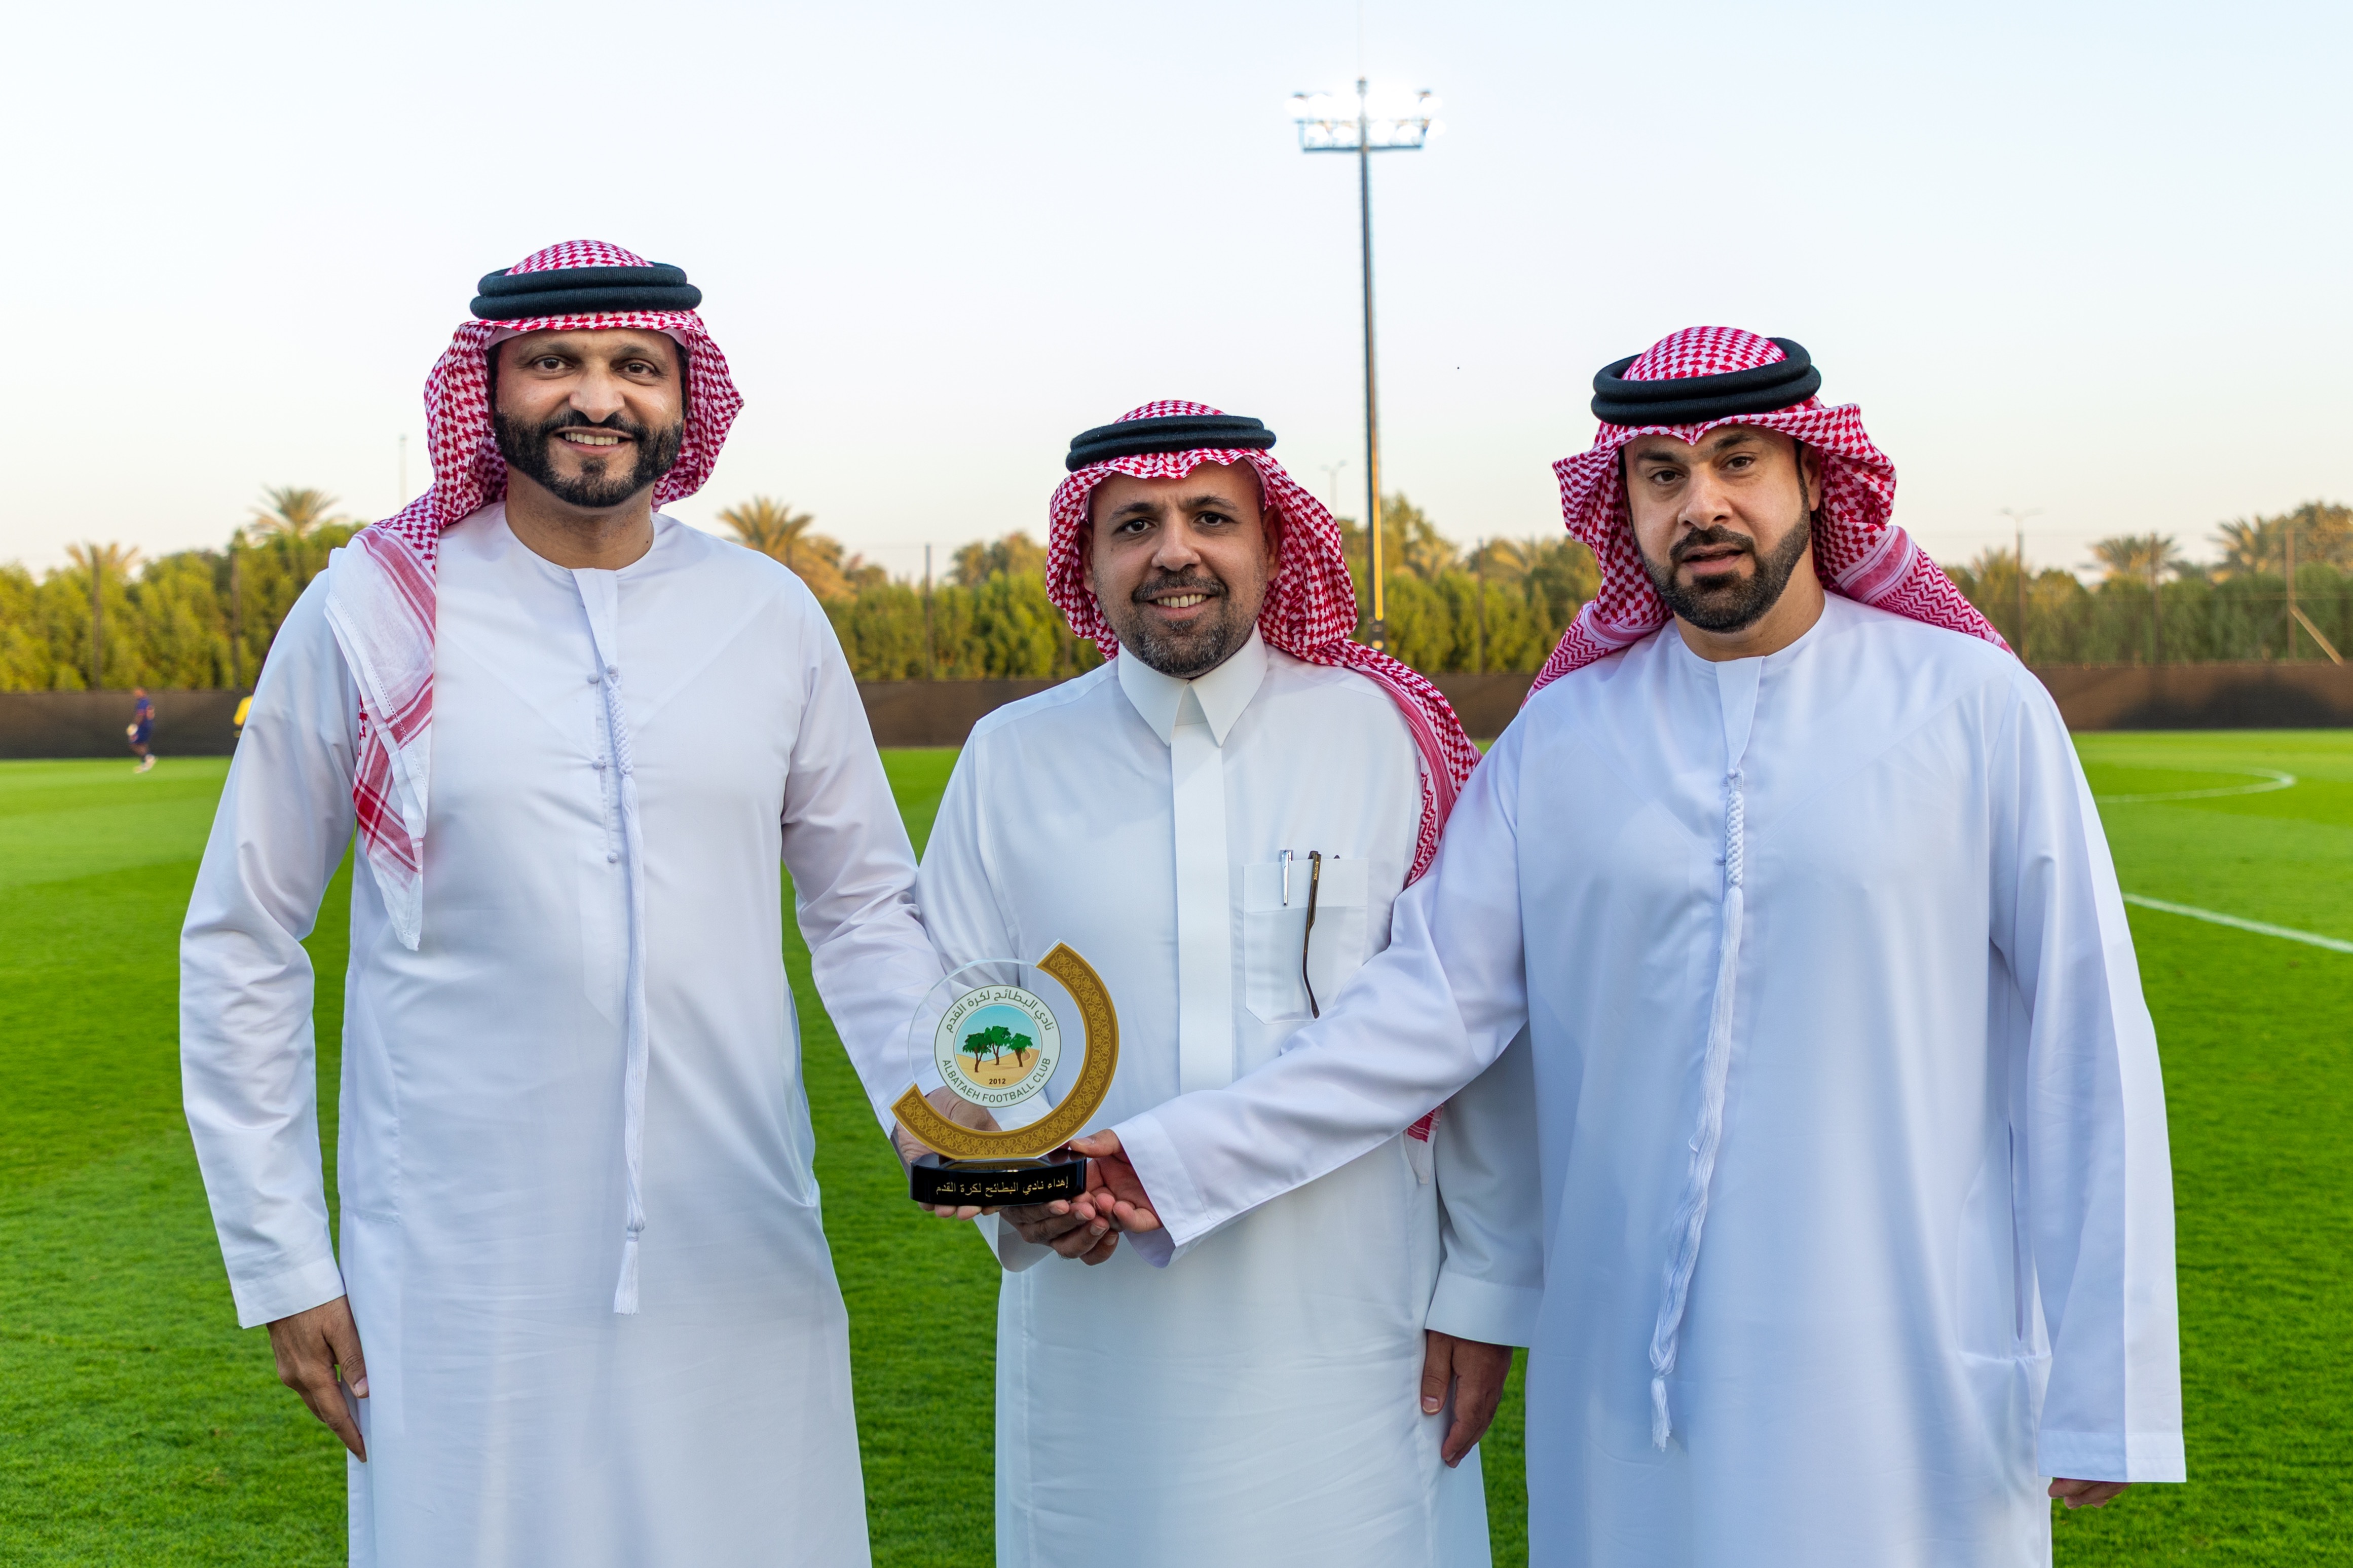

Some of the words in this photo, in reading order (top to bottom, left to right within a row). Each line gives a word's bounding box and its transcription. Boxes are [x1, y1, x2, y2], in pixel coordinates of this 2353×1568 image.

[967, 990, 990, 1007] لكرة
[994, 989, 1038, 1010] البطائح
[946, 1004, 966, 1033] القدم
[1034, 1010, 1054, 1030] نادي
[942, 1060, 981, 1100] ALBATAEH
[982, 1083, 1035, 1103] FOOTBALL
[1033, 1058, 1051, 1083] CLUB
[936, 1182, 956, 1195] القدم
[960, 1182, 982, 1196] لكرة
[985, 1182, 1019, 1197] البطائح
[1023, 1180, 1044, 1195] نادي
[1047, 1175, 1068, 1189] إهداء
